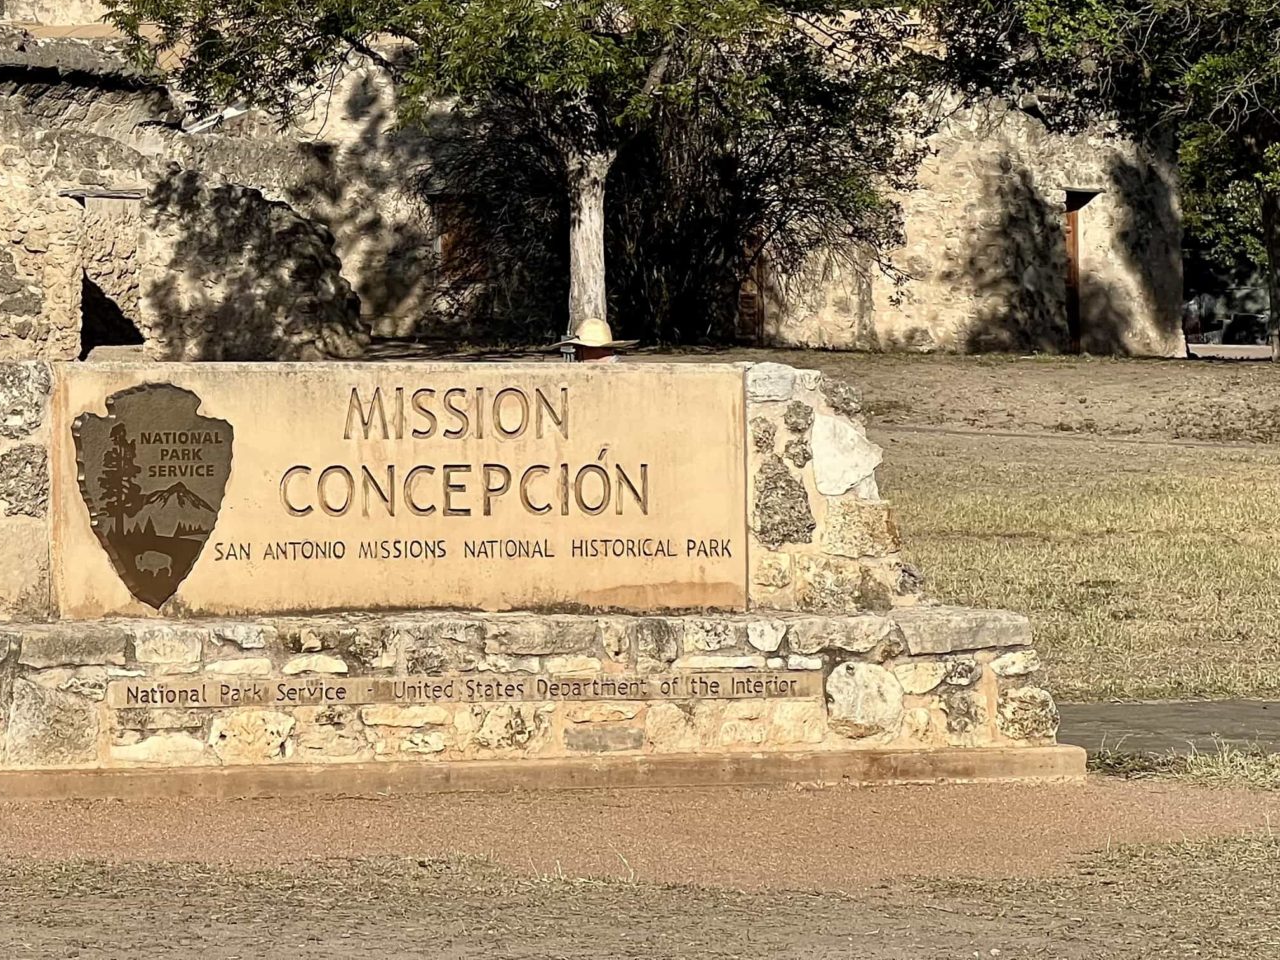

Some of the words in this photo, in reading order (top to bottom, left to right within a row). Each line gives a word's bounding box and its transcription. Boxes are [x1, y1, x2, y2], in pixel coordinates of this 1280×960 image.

[343, 387, 569, 440] MISSION
[140, 431, 223, 445] NATIONAL
[160, 448, 203, 461] PARK
[148, 464, 215, 478] SERVICE
[279, 447, 649, 517] CONCEPCIÓN
[214, 542, 251, 561] SAN
[263, 541, 346, 560] ANTONIO
[358, 540, 447, 559] MISSIONS
[464, 539, 555, 559] NATIONAL
[571, 538, 678, 558] HISTORICAL
[686, 538, 732, 558] PARK
[126, 684, 207, 705] National
[220, 684, 263, 703] Park
[276, 683, 347, 702] Service
[393, 679, 454, 700] United
[466, 679, 525, 699] States
[660, 676, 680, 696] of
[690, 676, 720, 695] the
[731, 676, 798, 696] Interior
